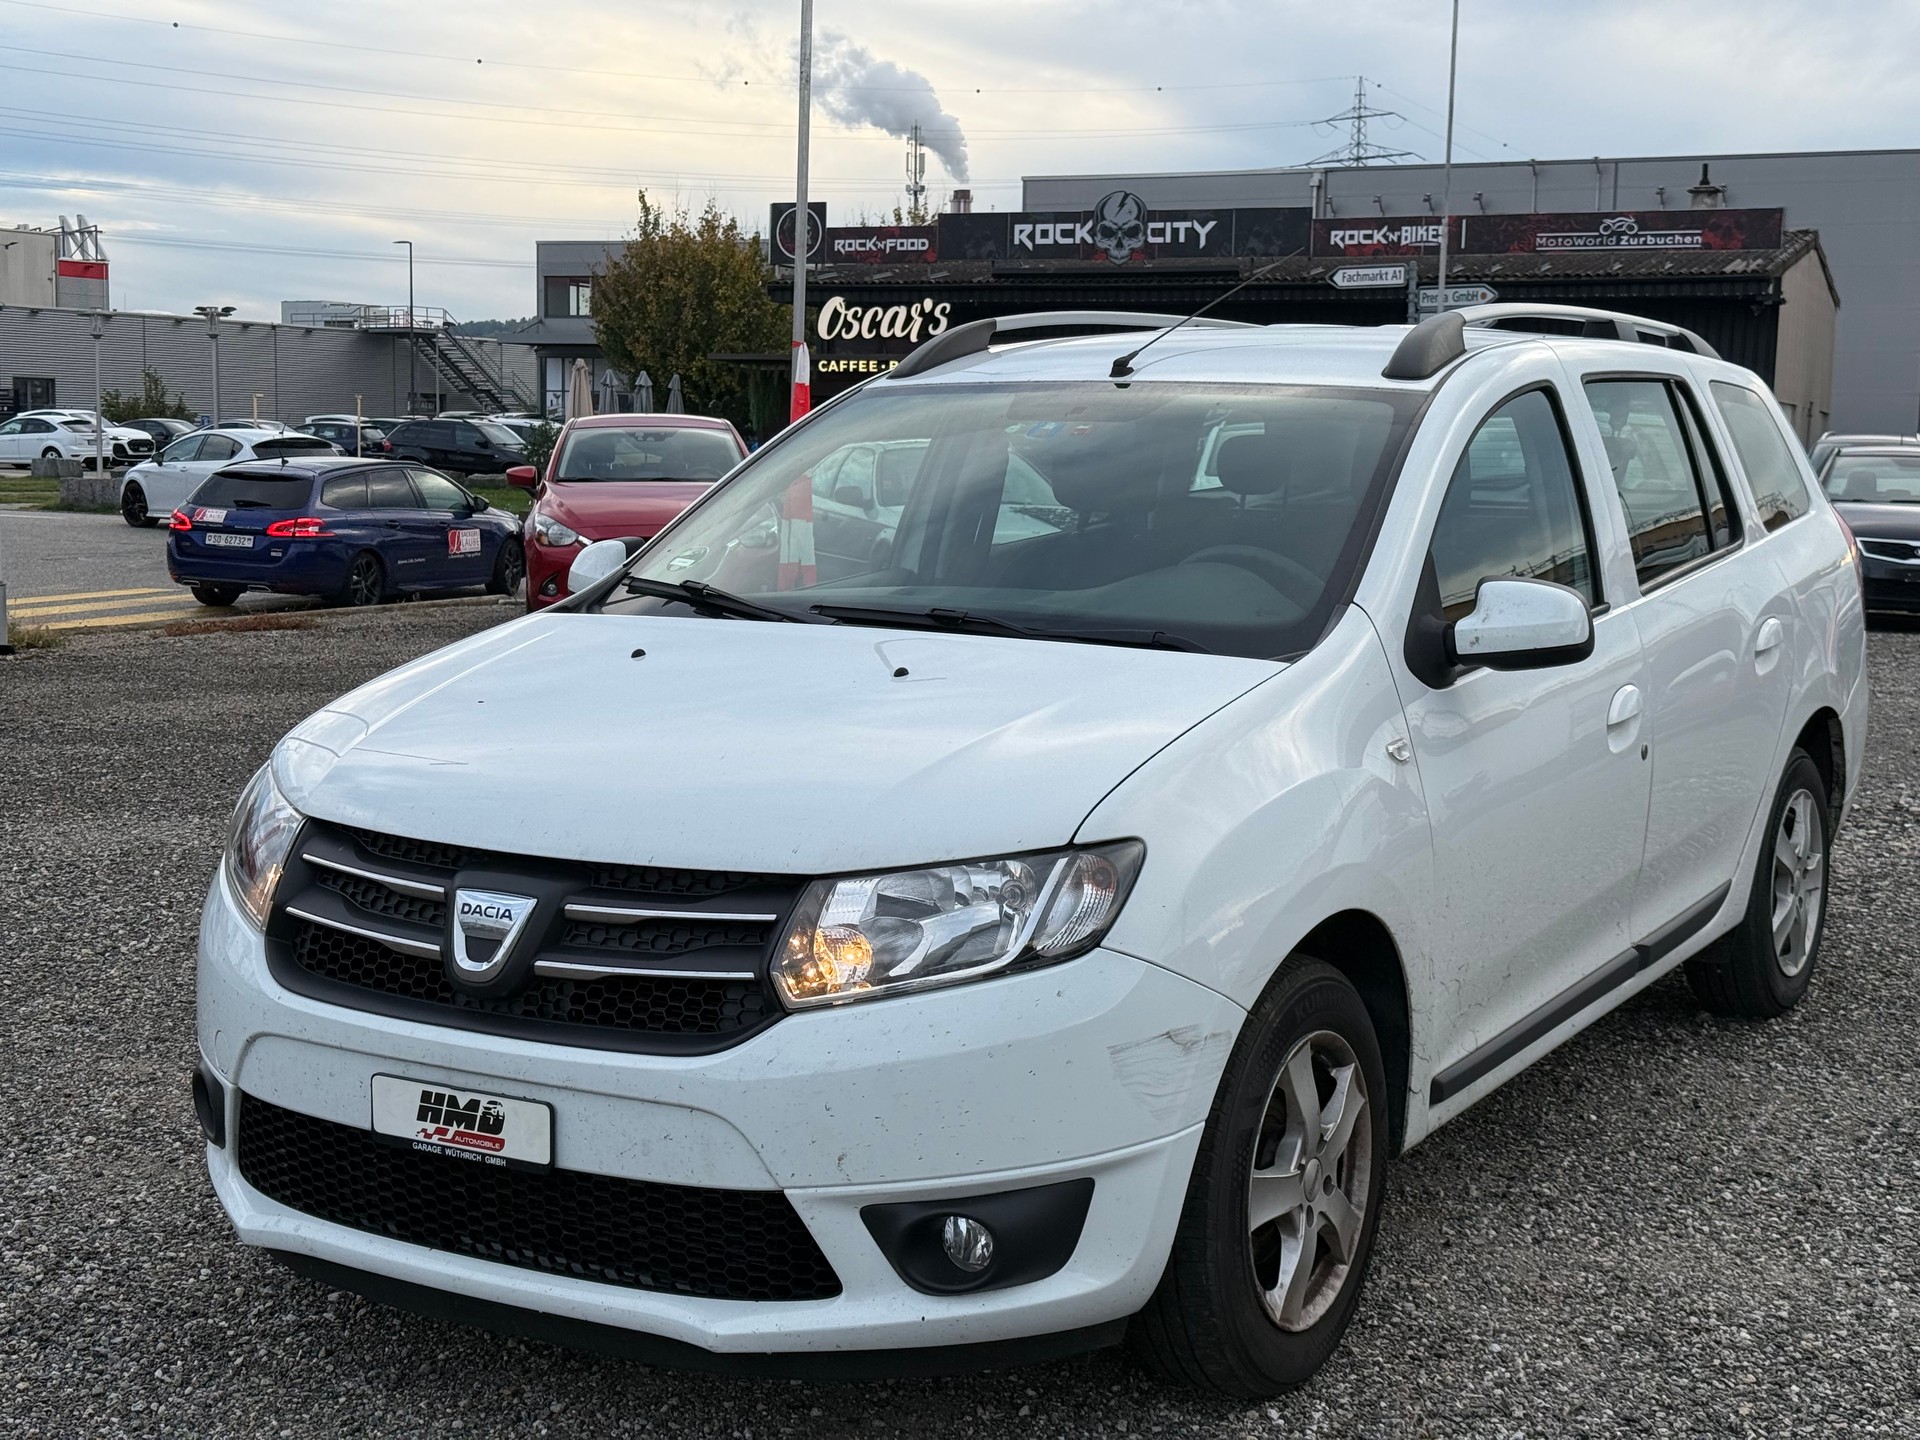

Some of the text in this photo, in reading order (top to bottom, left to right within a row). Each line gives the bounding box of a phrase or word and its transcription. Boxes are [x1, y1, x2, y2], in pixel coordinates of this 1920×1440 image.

[1014, 219, 1218, 251] ROCK CITY
[1536, 234, 1702, 248] MotoWorld Zurbuchen
[1341, 270, 1402, 283] Fachmarkt A1
[1452, 290, 1479, 303] GmbH
[817, 296, 951, 343] Oscar's
[818, 360, 878, 372] CAFFEE
[224, 535, 246, 546] 62732
[460, 902, 513, 921] DACIA
[454, 1135, 501, 1149] AUTOMOBILE
[412, 1142, 507, 1167] GARAGE WÜTHRICH GMBH
